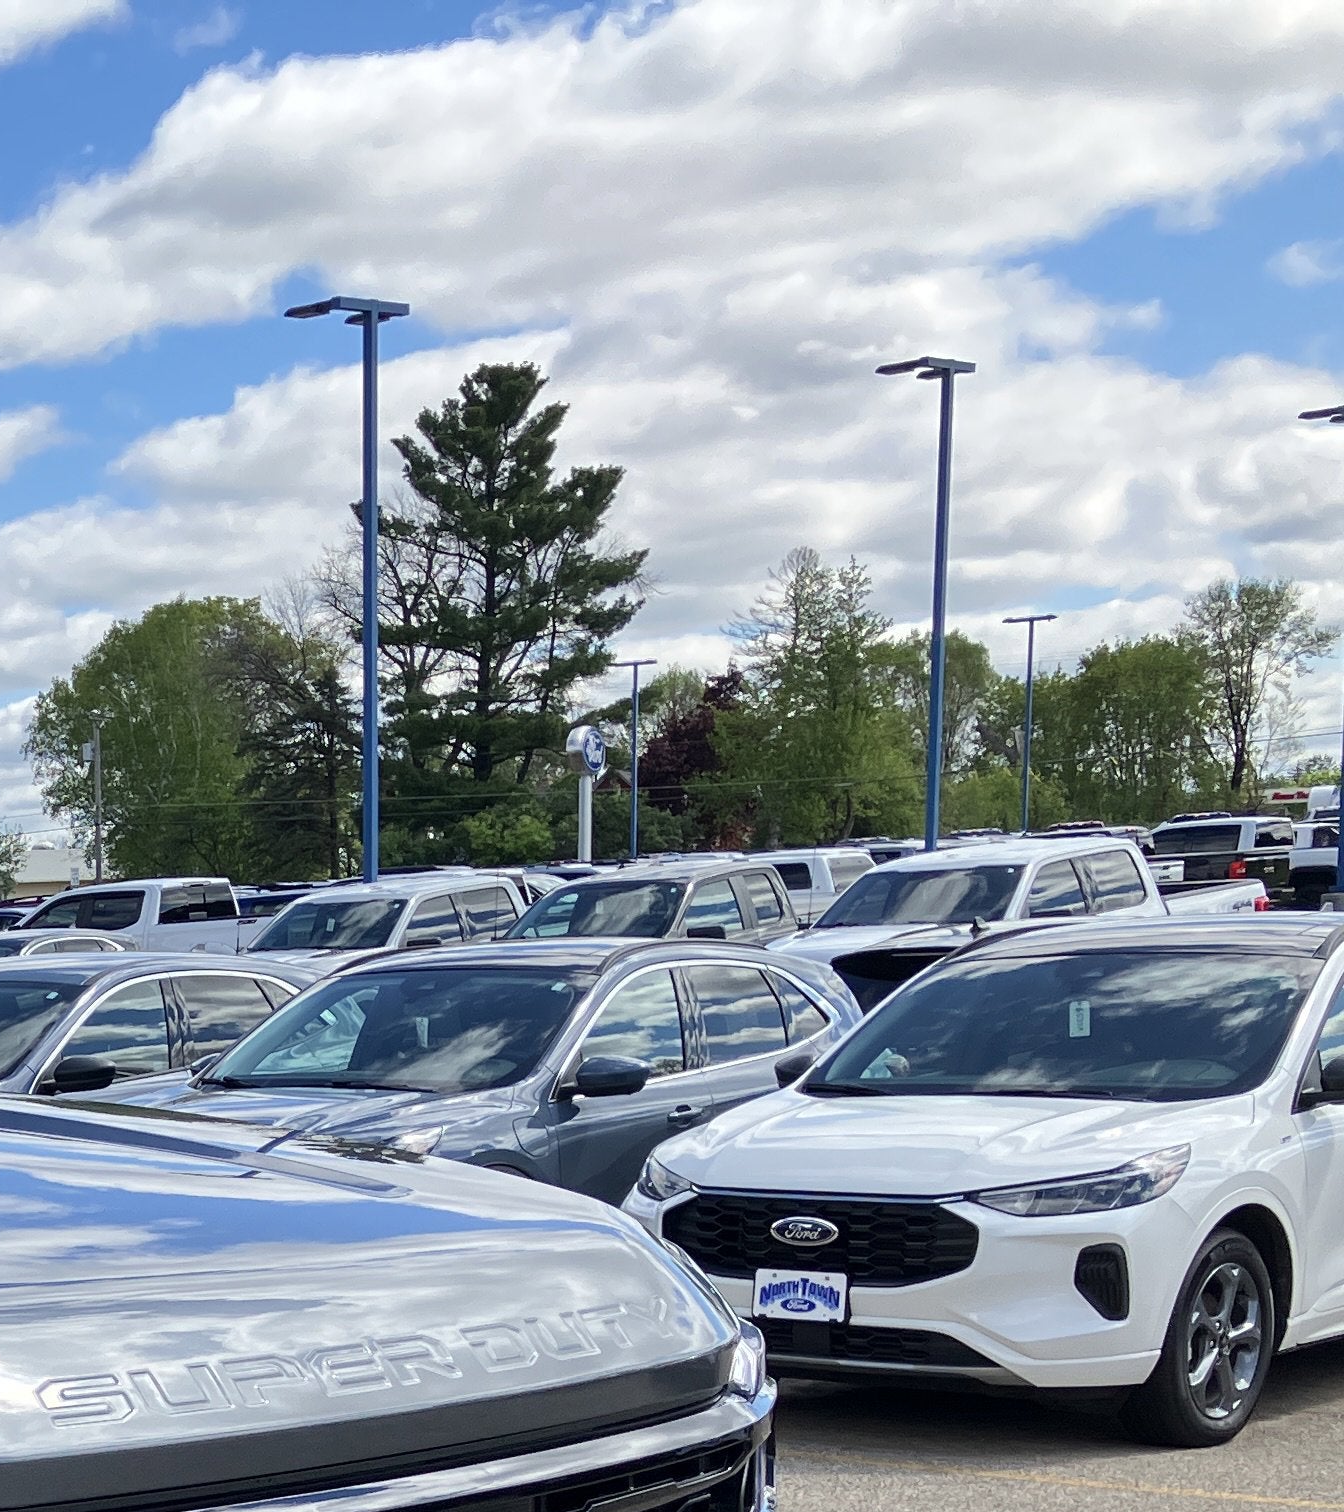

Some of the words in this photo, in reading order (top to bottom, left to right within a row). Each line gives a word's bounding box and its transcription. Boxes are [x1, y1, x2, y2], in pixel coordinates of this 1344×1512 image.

[784, 1222, 822, 1240] Ford
[787, 1299, 810, 1310] Ford
[33, 1333, 464, 1429] SUPER
[459, 1296, 674, 1373] DUTY
